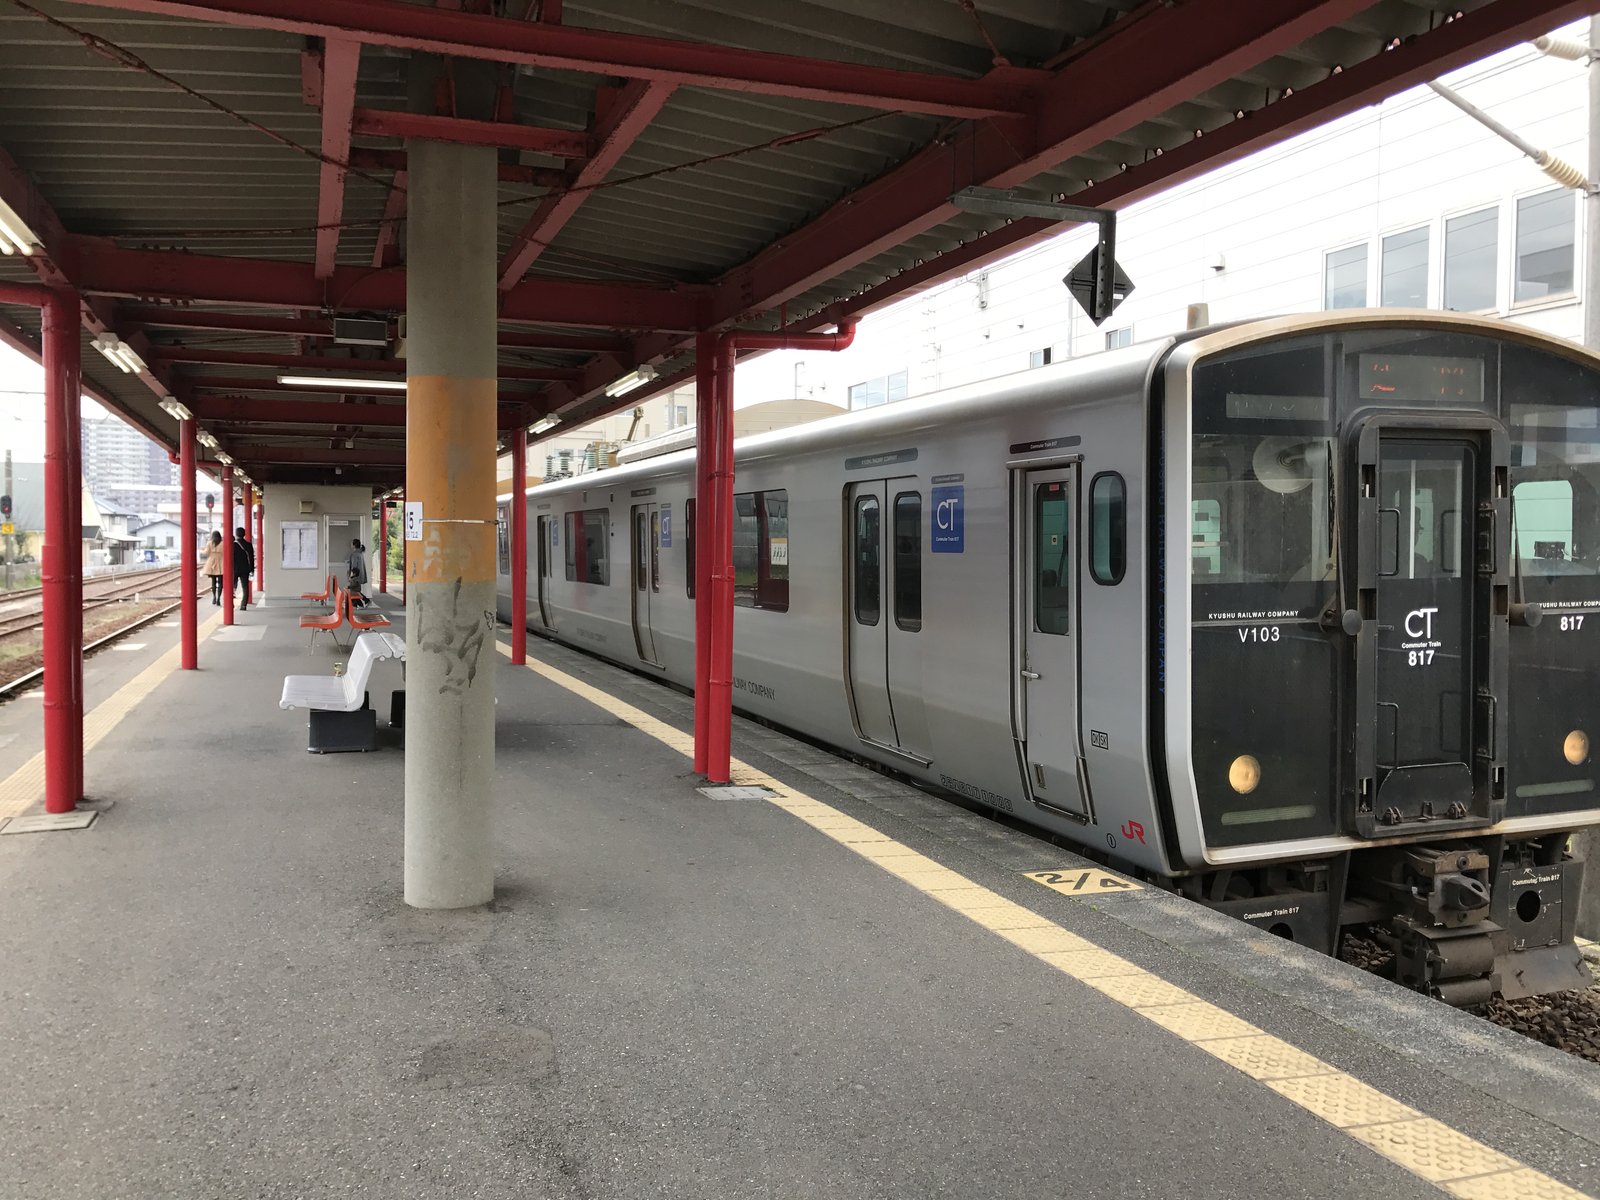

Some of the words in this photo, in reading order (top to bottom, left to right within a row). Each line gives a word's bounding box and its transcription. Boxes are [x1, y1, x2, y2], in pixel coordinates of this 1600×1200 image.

[937, 499, 958, 531] CT
[1267, 610, 1299, 618] COMPANY
[1404, 607, 1439, 639] CT
[1560, 615, 1585, 631] 817
[1238, 626, 1280, 643] V103
[1408, 650, 1435, 667] 817
[1121, 819, 1146, 845] JR
[1034, 872, 1131, 890] 2/4
[1243, 911, 1273, 920] Commuter
[1288, 906, 1300, 914] 817
